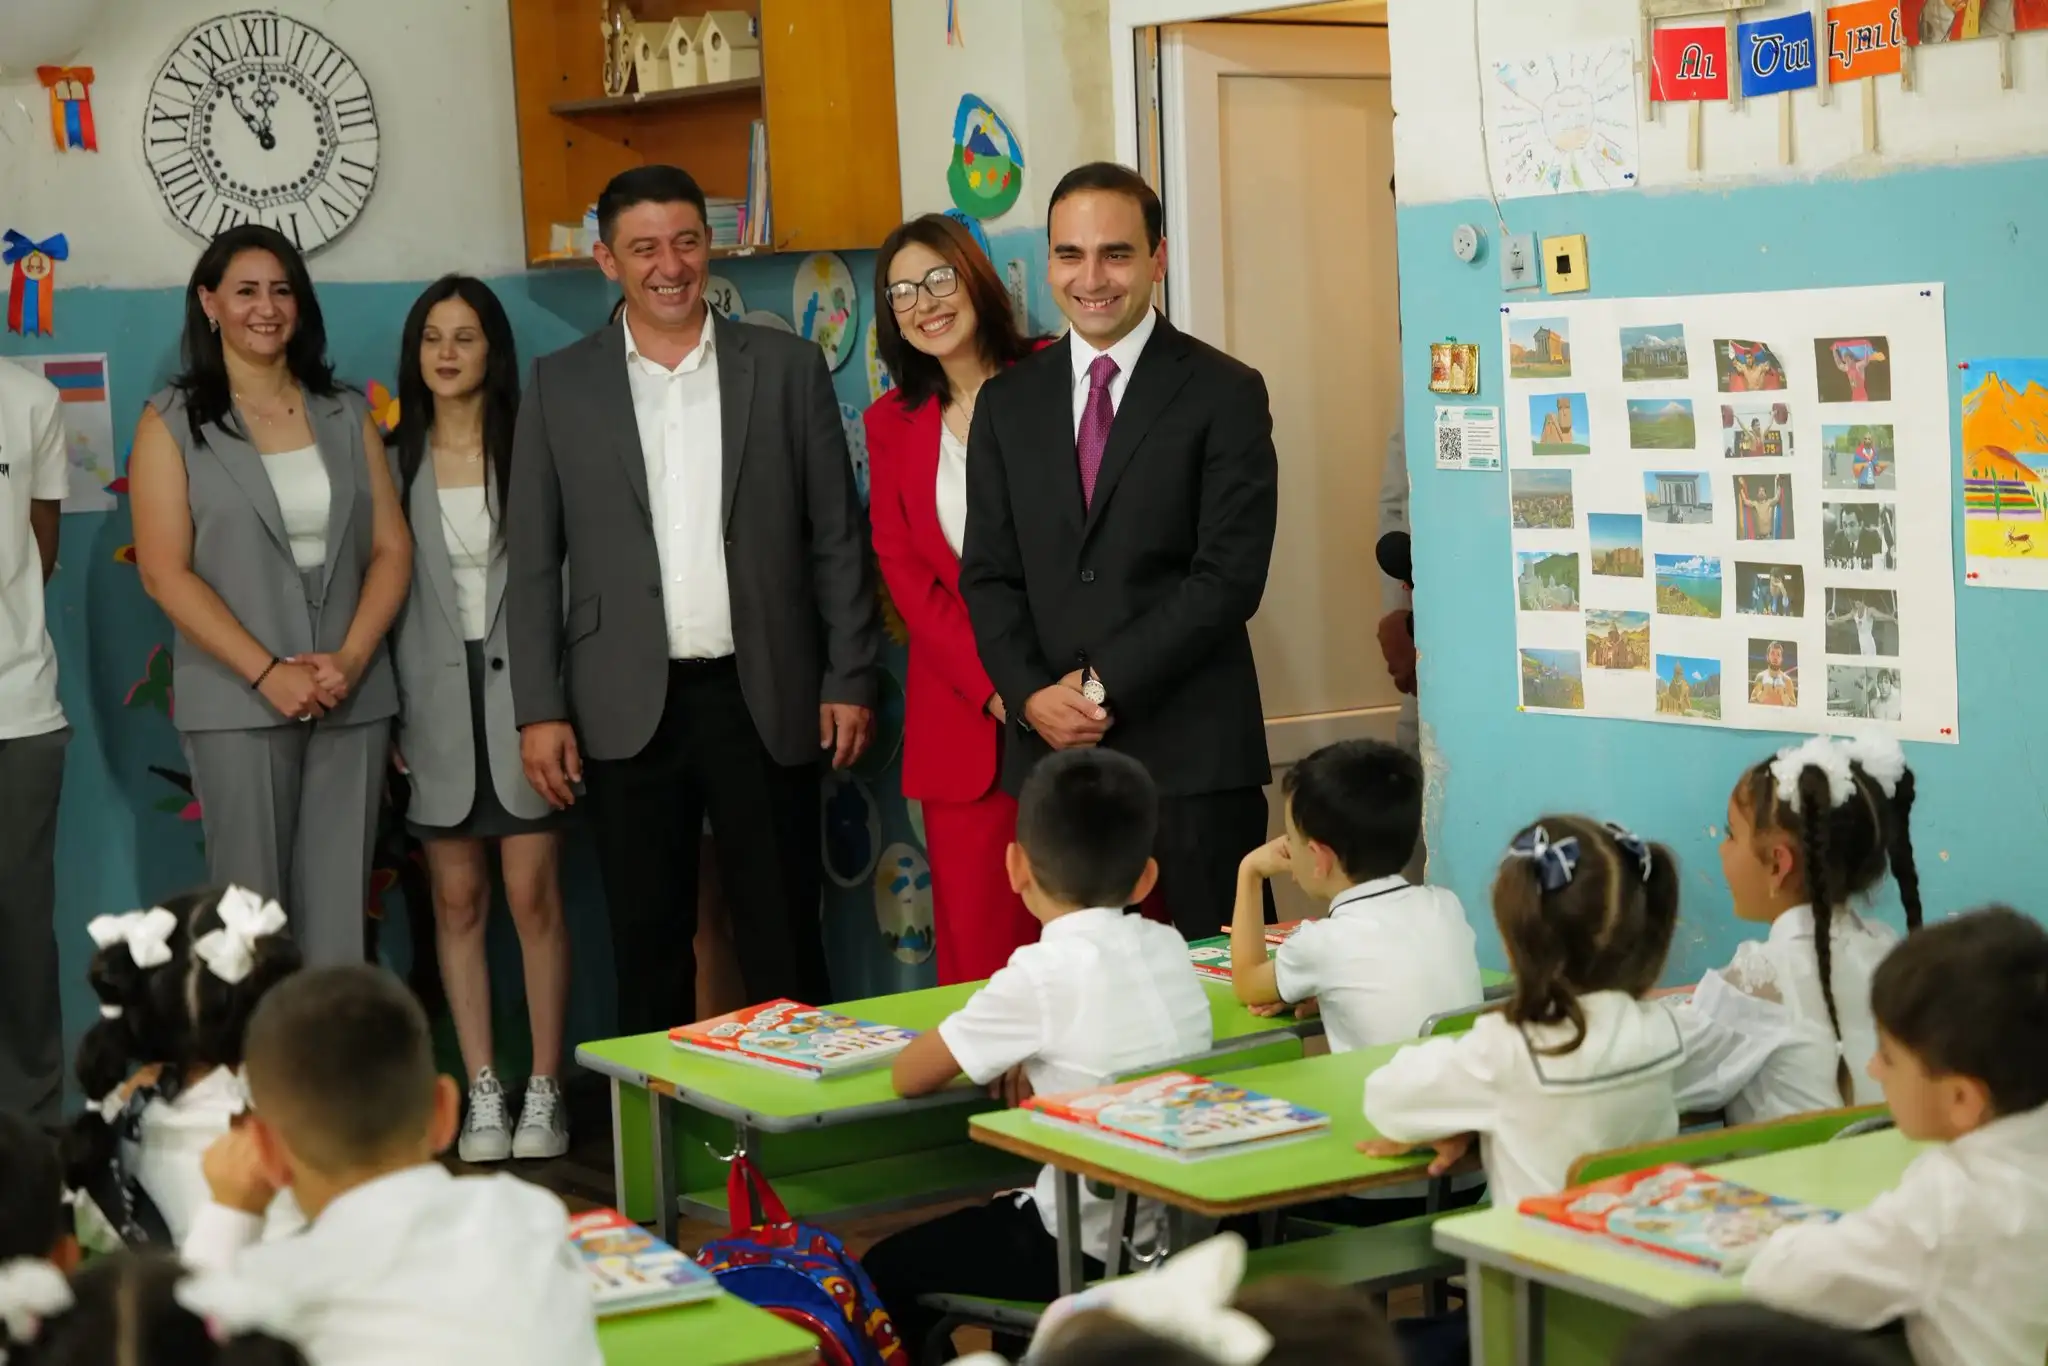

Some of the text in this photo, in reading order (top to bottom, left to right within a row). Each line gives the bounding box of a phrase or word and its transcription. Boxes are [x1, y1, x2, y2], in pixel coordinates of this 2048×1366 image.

[194, 24, 237, 72] XI
[240, 18, 280, 57] XII
[292, 30, 310, 65] I
[164, 62, 204, 101] X
[311, 47, 346, 88] II
[150, 103, 191, 147] IX
[335, 94, 375, 131] III
[160, 157, 207, 221] VIII
[319, 195, 350, 230] V
